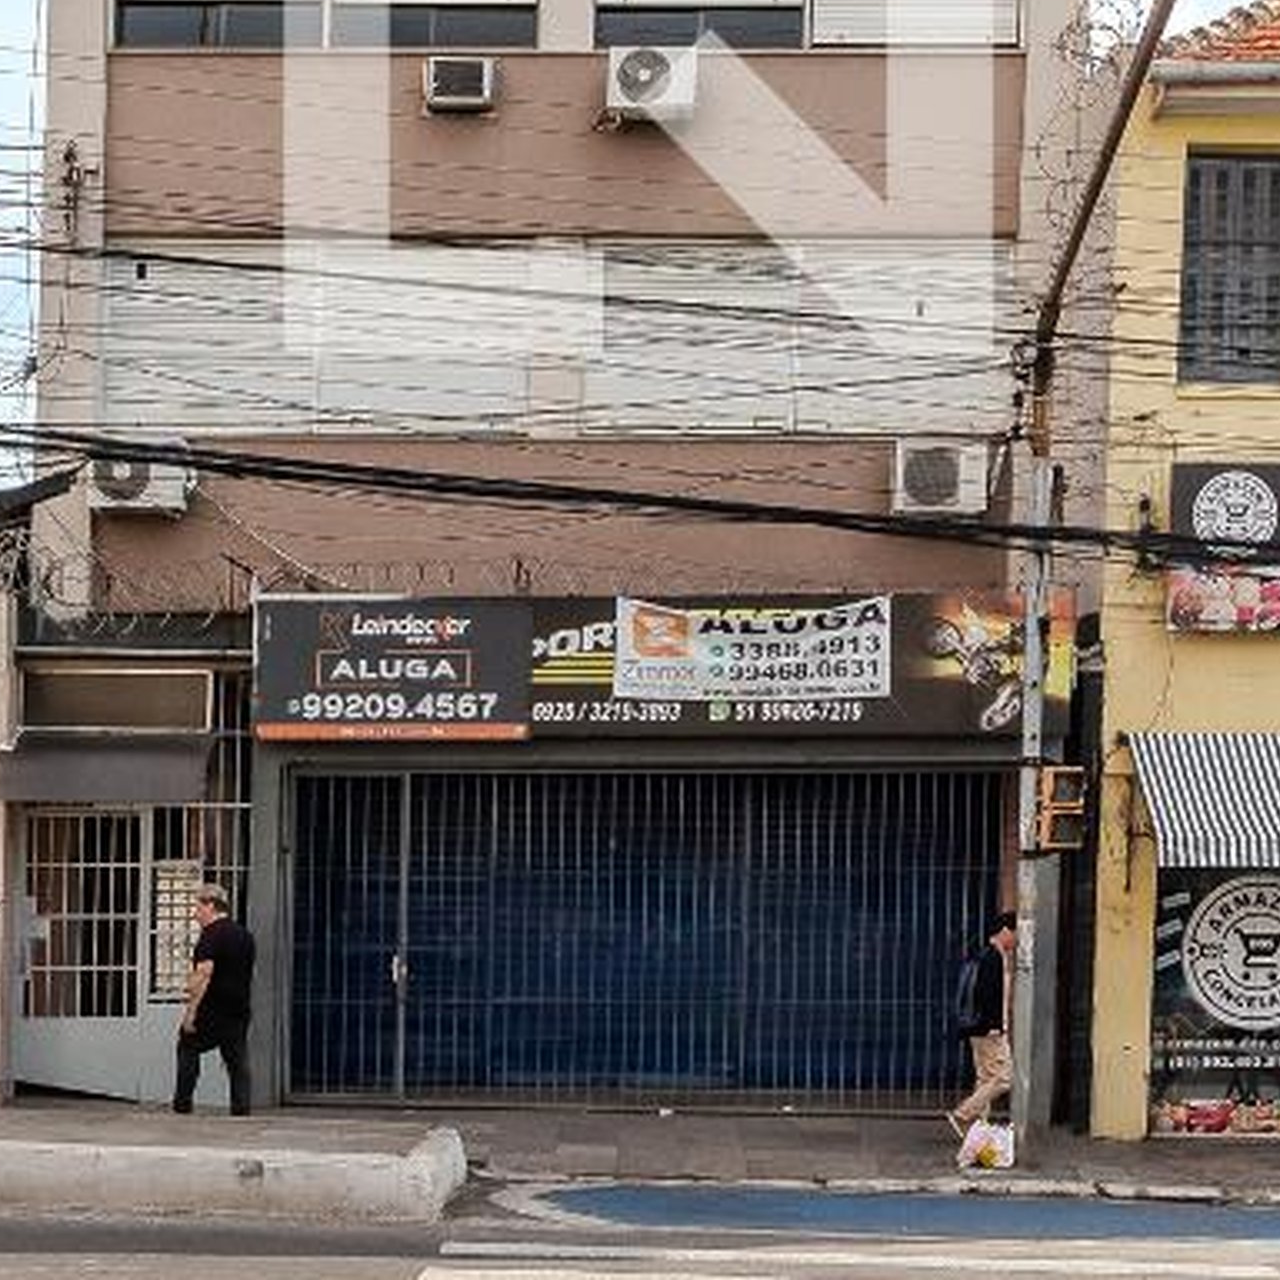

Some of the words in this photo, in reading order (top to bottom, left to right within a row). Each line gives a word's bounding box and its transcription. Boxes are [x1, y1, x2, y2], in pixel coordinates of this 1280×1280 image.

[698, 604, 886, 634] ALUGA
[329, 659, 457, 680] ALUGA
[302, 693, 498, 719] 99209.4567
